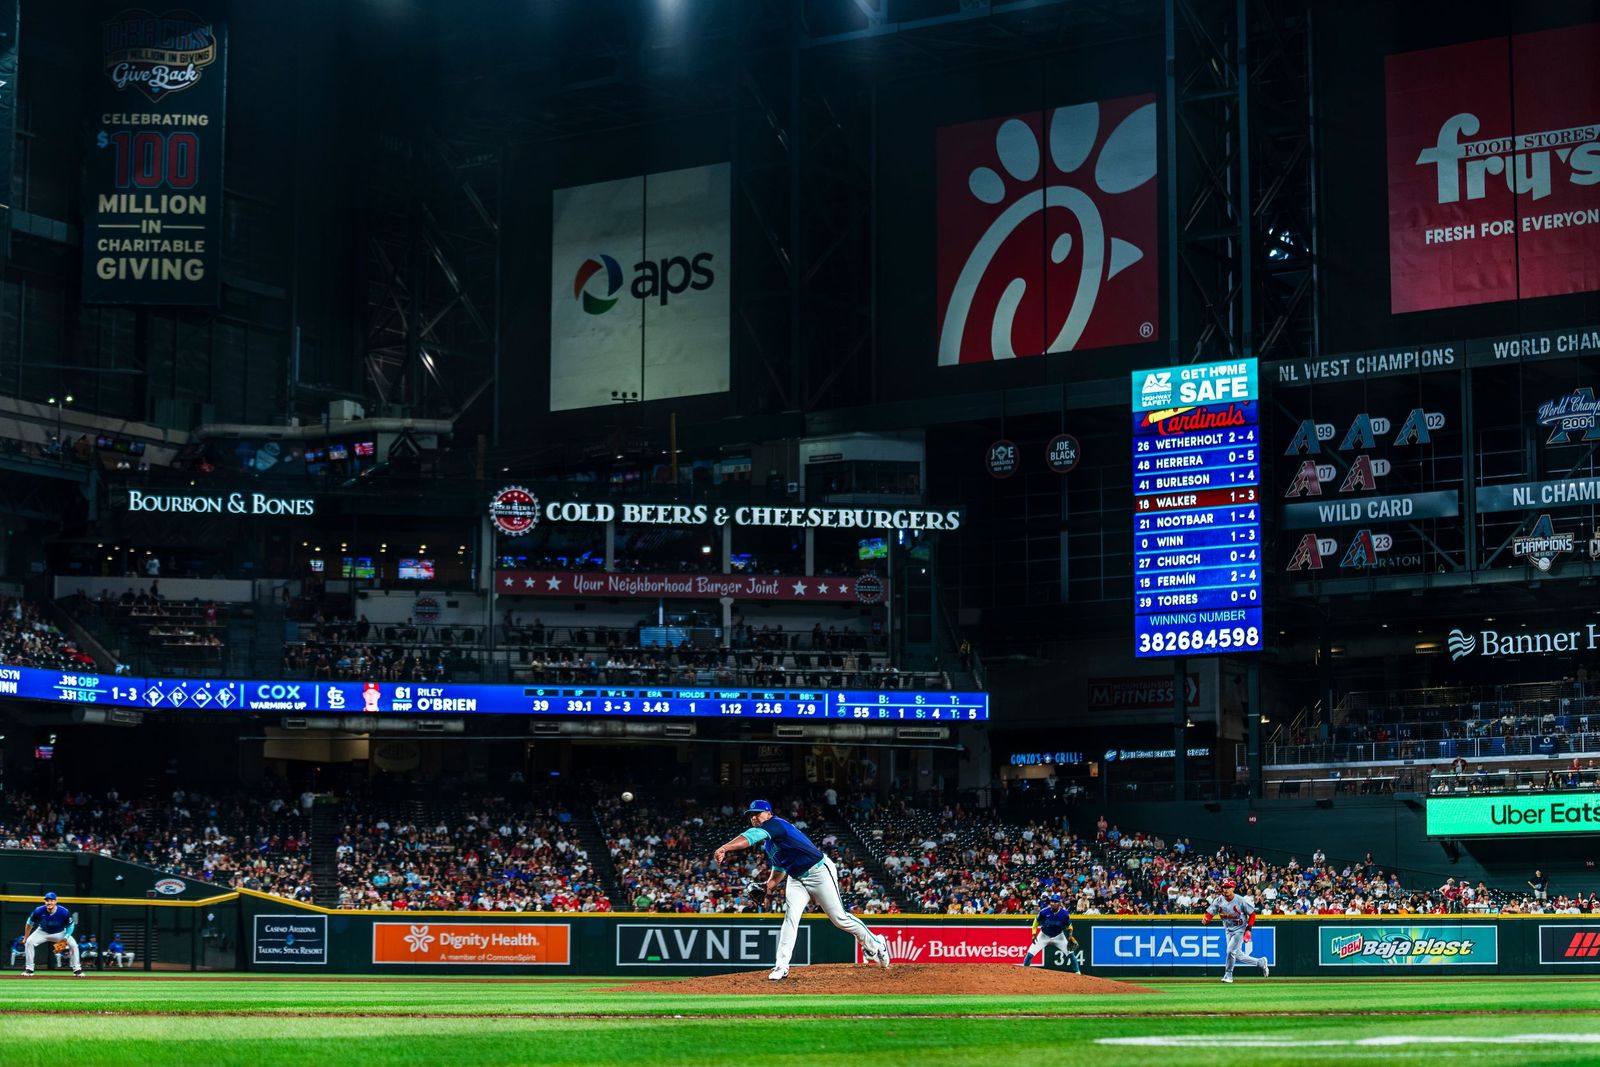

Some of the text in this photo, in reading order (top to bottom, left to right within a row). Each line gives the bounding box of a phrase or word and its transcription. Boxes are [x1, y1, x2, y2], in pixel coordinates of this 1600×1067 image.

[112, 62, 199, 89] Give Back
[102, 114, 209, 127] CELEBRATING
[1463, 127, 1596, 157] FOOD STORES
[97, 131, 199, 190] $100
[1415, 112, 1600, 204] fry's
[98, 194, 206, 215] MILLION
[141, 219, 162, 234] IN
[1425, 224, 1475, 245] FRESH
[1481, 219, 1515, 238] FOR
[97, 239, 205, 253] CHARITABLE
[96, 257, 205, 281] GIVING
[630, 252, 715, 307] aps
[1493, 337, 1551, 360] WORLD
[1279, 348, 1455, 382] NL WEST CHAMPIONS
[1142, 372, 1172, 394] AZ
[1181, 367, 1208, 381] GET
[1180, 376, 1249, 404] SAFE
[1142, 399, 1172, 408] SAFETY
[1538, 397, 1569, 420] World
[1158, 404, 1246, 436] Cardinals
[1373, 421, 1386, 433] 01
[1427, 416, 1442, 427] 02
[1562, 416, 1595, 430] 2001
[1317, 426, 1333, 438] 99
[1056, 440, 1070, 451] JOE
[1137, 433, 1223, 452] 26 WETHERHOLT
[1049, 449, 1076, 461] BLACK
[1137, 455, 1204, 471] 48 HERRERA
[1318, 467, 1332, 479] 07
[1373, 462, 1386, 474] 11
[1139, 474, 1210, 490] 41 BURLESON
[1513, 480, 1600, 506] NL CHAM
[227, 493, 246, 513] &
[1138, 499, 1150, 510] 18
[1156, 494, 1197, 508] WALKER
[546, 502, 960, 530] COLD BEERS & CHEESEBURGERS
[1318, 498, 1413, 523] WILD CARD
[1139, 519, 1150, 529] 21
[1156, 512, 1214, 528] NOOTBAAR
[1141, 538, 1149, 549] 0
[1156, 535, 1184, 548] WINN
[1321, 541, 1333, 553] 17
[1375, 536, 1390, 549] 23
[1514, 538, 1573, 556] CHAMPIONS
[1139, 558, 1151, 569] 27
[1157, 553, 1201, 567] CHURCH
[573, 574, 779, 596] Your Neighborhood Burger Joint
[1139, 577, 1151, 588] 15
[1157, 571, 1196, 587] FERMÍN
[1139, 597, 1152, 608] 39
[1157, 593, 1198, 607] TORRES
[1149, 610, 1246, 626] WINNING NUMBER
[1139, 626, 1259, 653] 382684598
[1480, 630, 1581, 656] Banner
[58, 675, 99, 688] .316 OBP
[58, 689, 97, 702] .331 SLG
[257, 684, 300, 699] COX
[394, 687, 411, 699] 61
[417, 687, 444, 697] RILEY
[574, 689, 584, 697] IP
[647, 690, 662, 698] ERA
[679, 691, 706, 699] HOLDS
[878, 695, 960, 704] B: S: T:
[1113, 688, 1175, 705] FITNESS
[250, 701, 307, 710] WARMING UP
[392, 702, 412, 711] RHP
[417, 698, 477, 712] O'BRIEN
[532, 700, 816, 715] 39 39.1 3.43 1 1.12 23.6 7.9
[853, 707, 977, 719] 55 B: 1 S: 4 T: 5
[1491, 802, 1600, 825] Uber Eats
[264, 924, 316, 934] CASINO ARIZONA
[439, 932, 489, 949] Dignity
[1114, 935, 1221, 958] CHASE
[1362, 938, 1473, 959] Baja Blast
[258, 946, 323, 955] TALKING STICK RESORT
[928, 940, 1028, 958] Budweiser
[440, 953, 536, 962] A member of CommonSpirit
